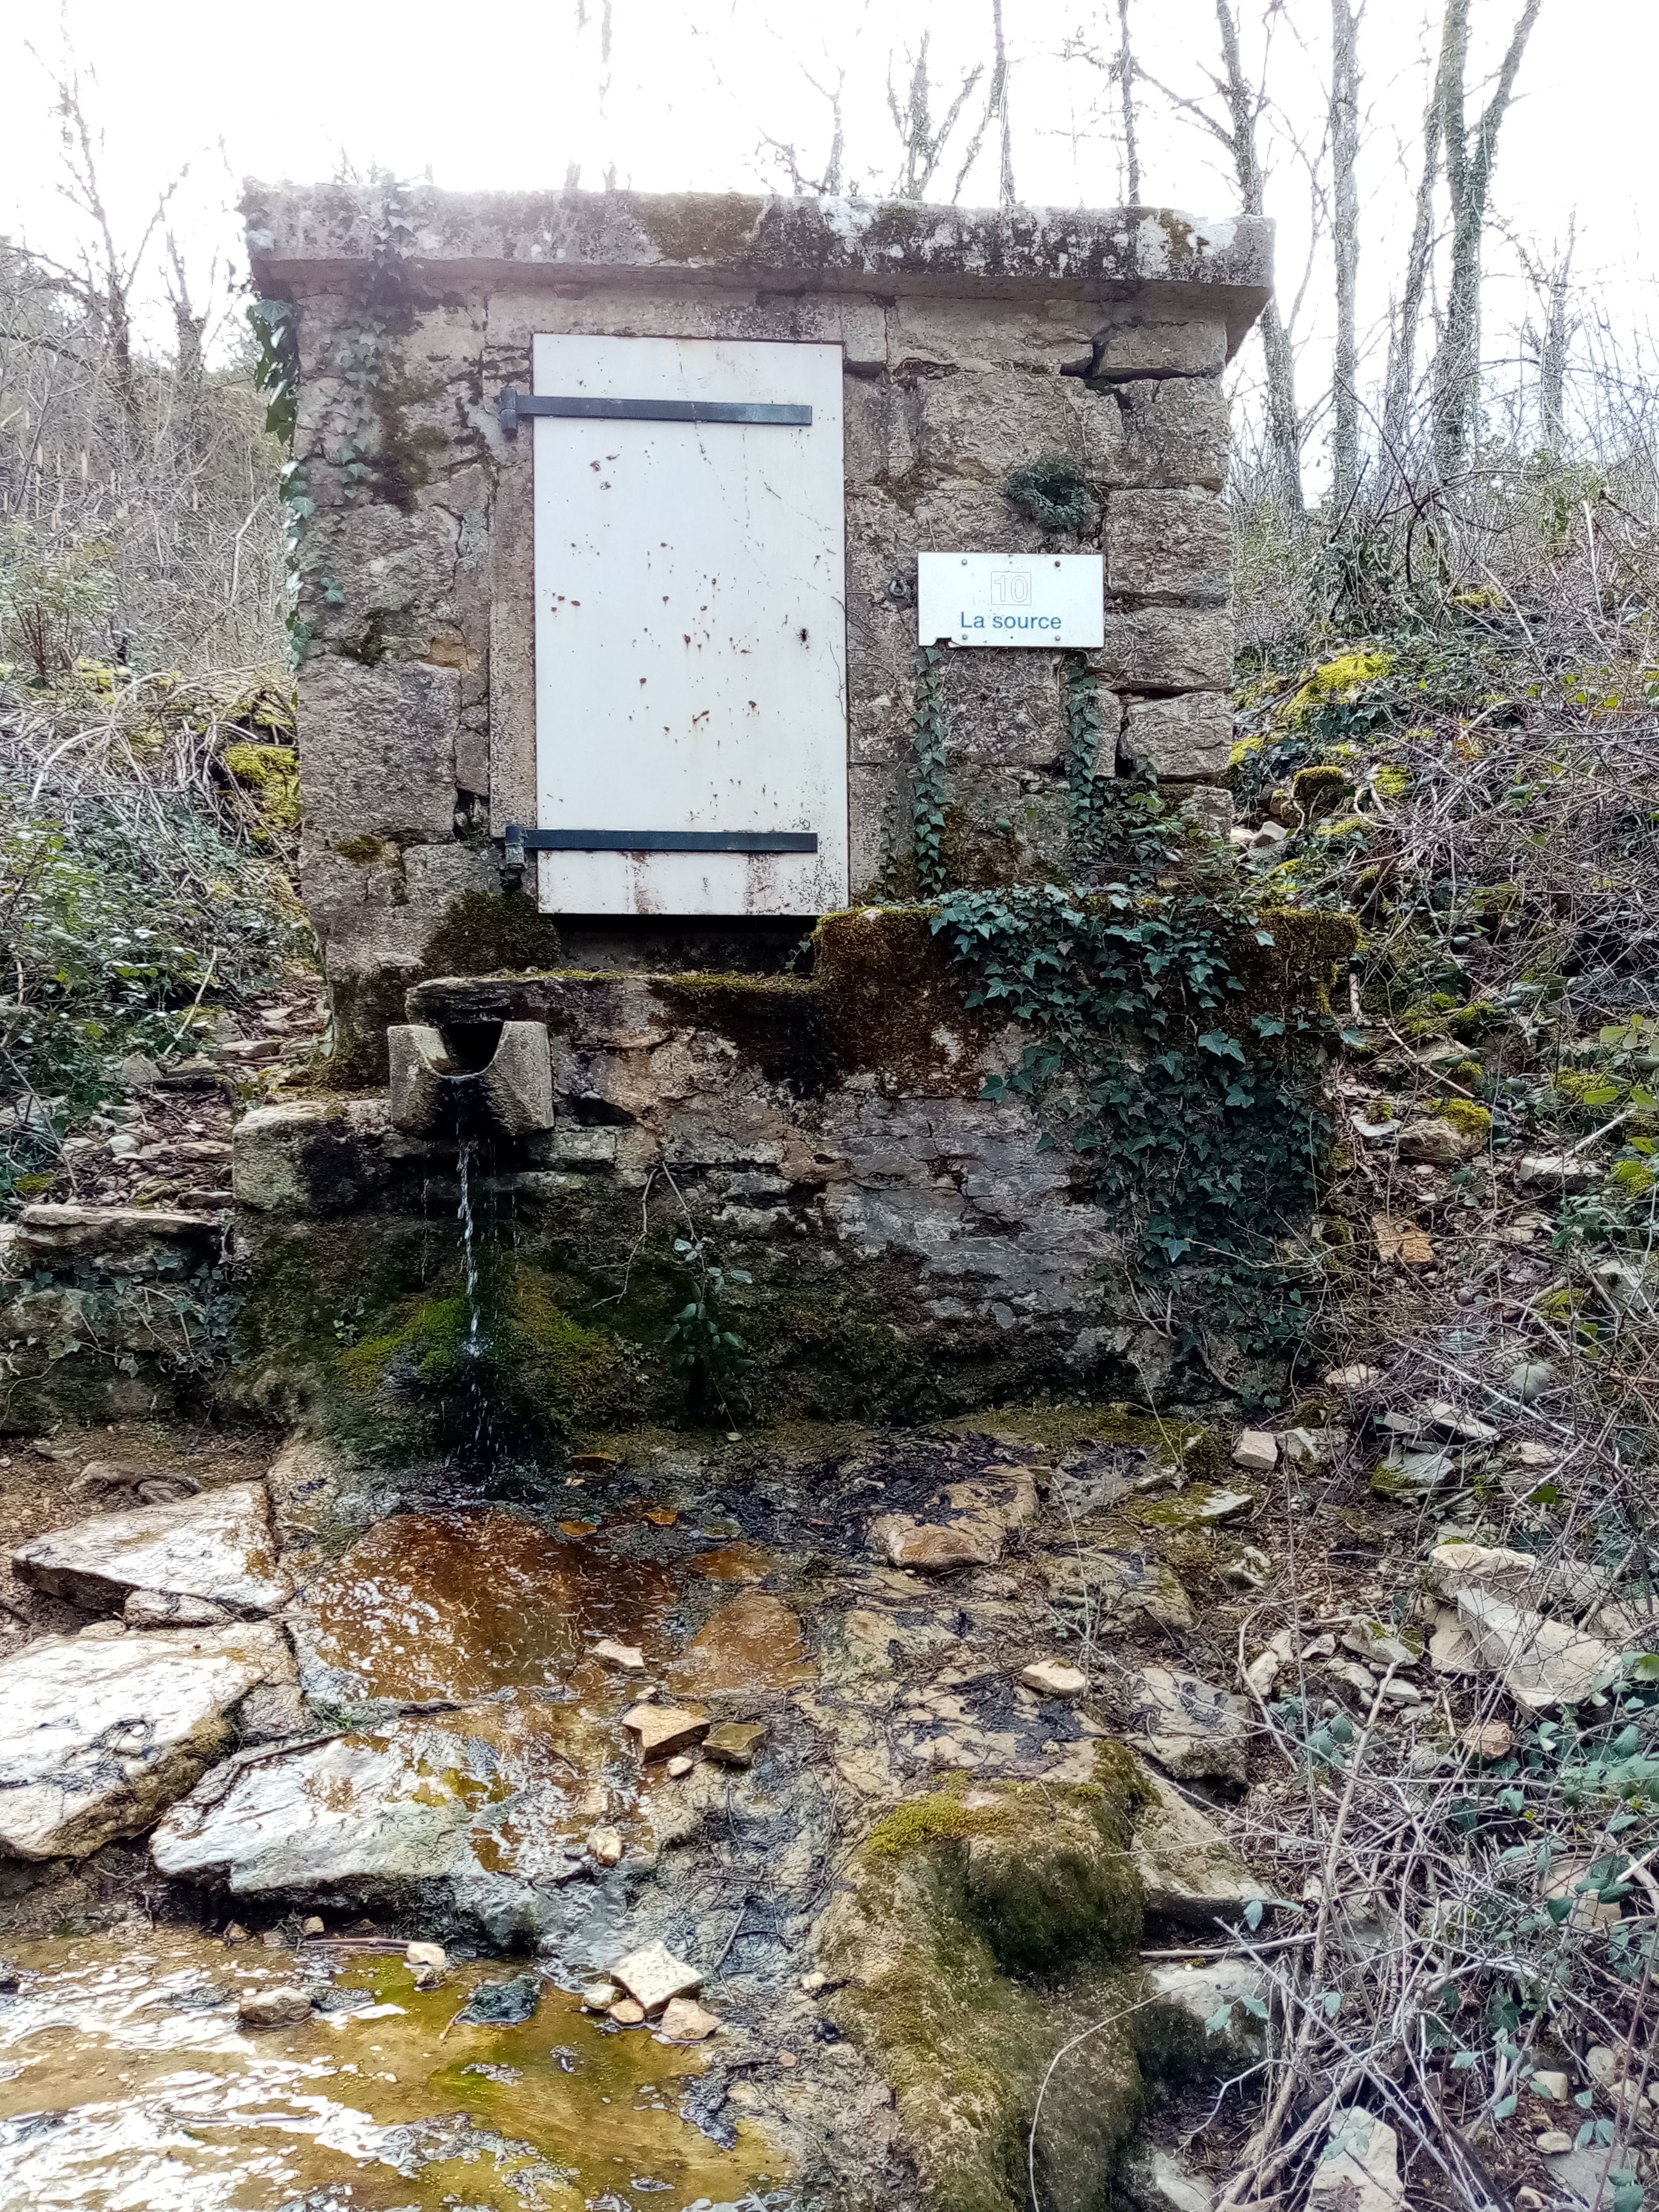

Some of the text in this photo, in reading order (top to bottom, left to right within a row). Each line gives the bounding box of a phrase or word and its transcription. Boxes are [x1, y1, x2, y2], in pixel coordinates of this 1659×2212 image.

[994, 575, 1028, 602] 10
[961, 611, 1062, 630] La source
